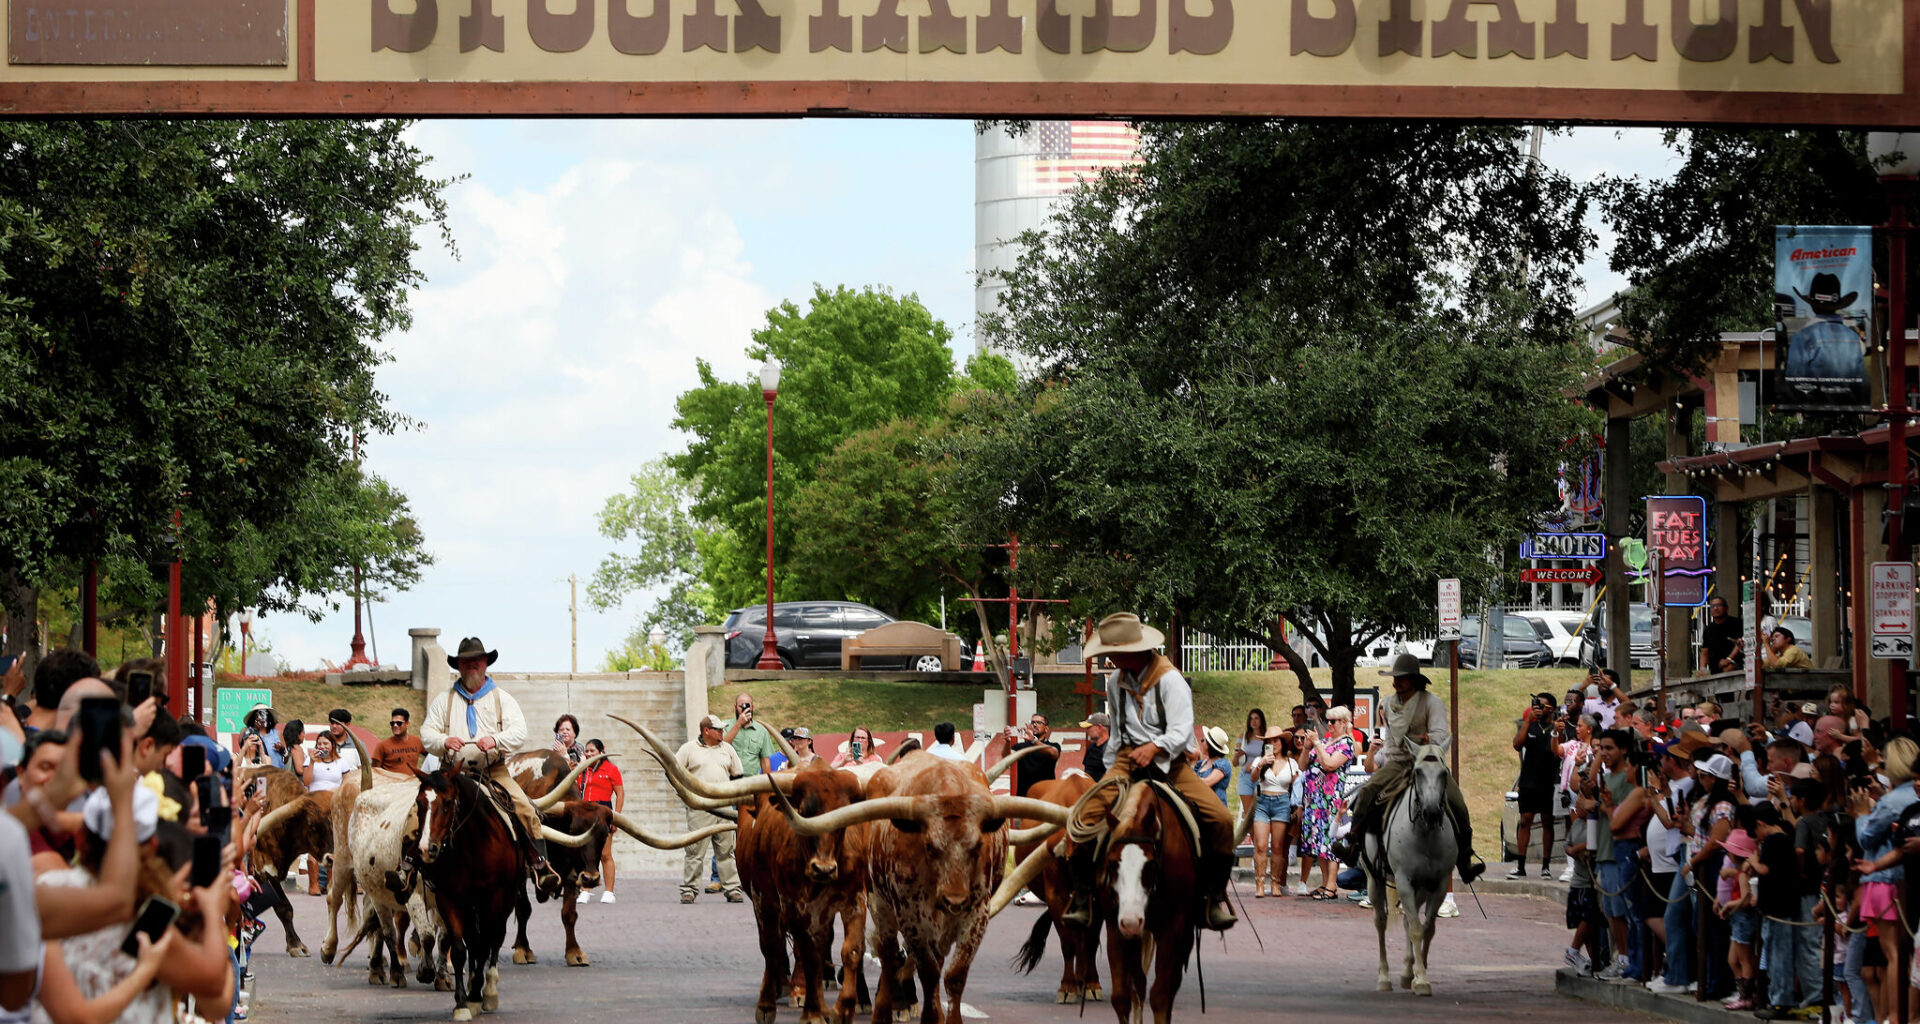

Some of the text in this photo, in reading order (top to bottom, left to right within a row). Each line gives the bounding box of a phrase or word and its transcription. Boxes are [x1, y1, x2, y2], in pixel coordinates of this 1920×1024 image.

[1790, 247, 1857, 262] American
[1652, 511, 1700, 529] FAT
[1652, 530, 1700, 545] TUES
[1533, 535, 1600, 555] BOOTS
[1537, 570, 1592, 579] WELCOME
[1887, 570, 1899, 579] NO
[1876, 581, 1910, 590] PARKING
[1876, 591, 1910, 599] STOPPING
[1888, 600, 1898, 608] OR
[1876, 609, 1910, 617] STANDING
[222, 691, 267, 702] TO N MAIN
